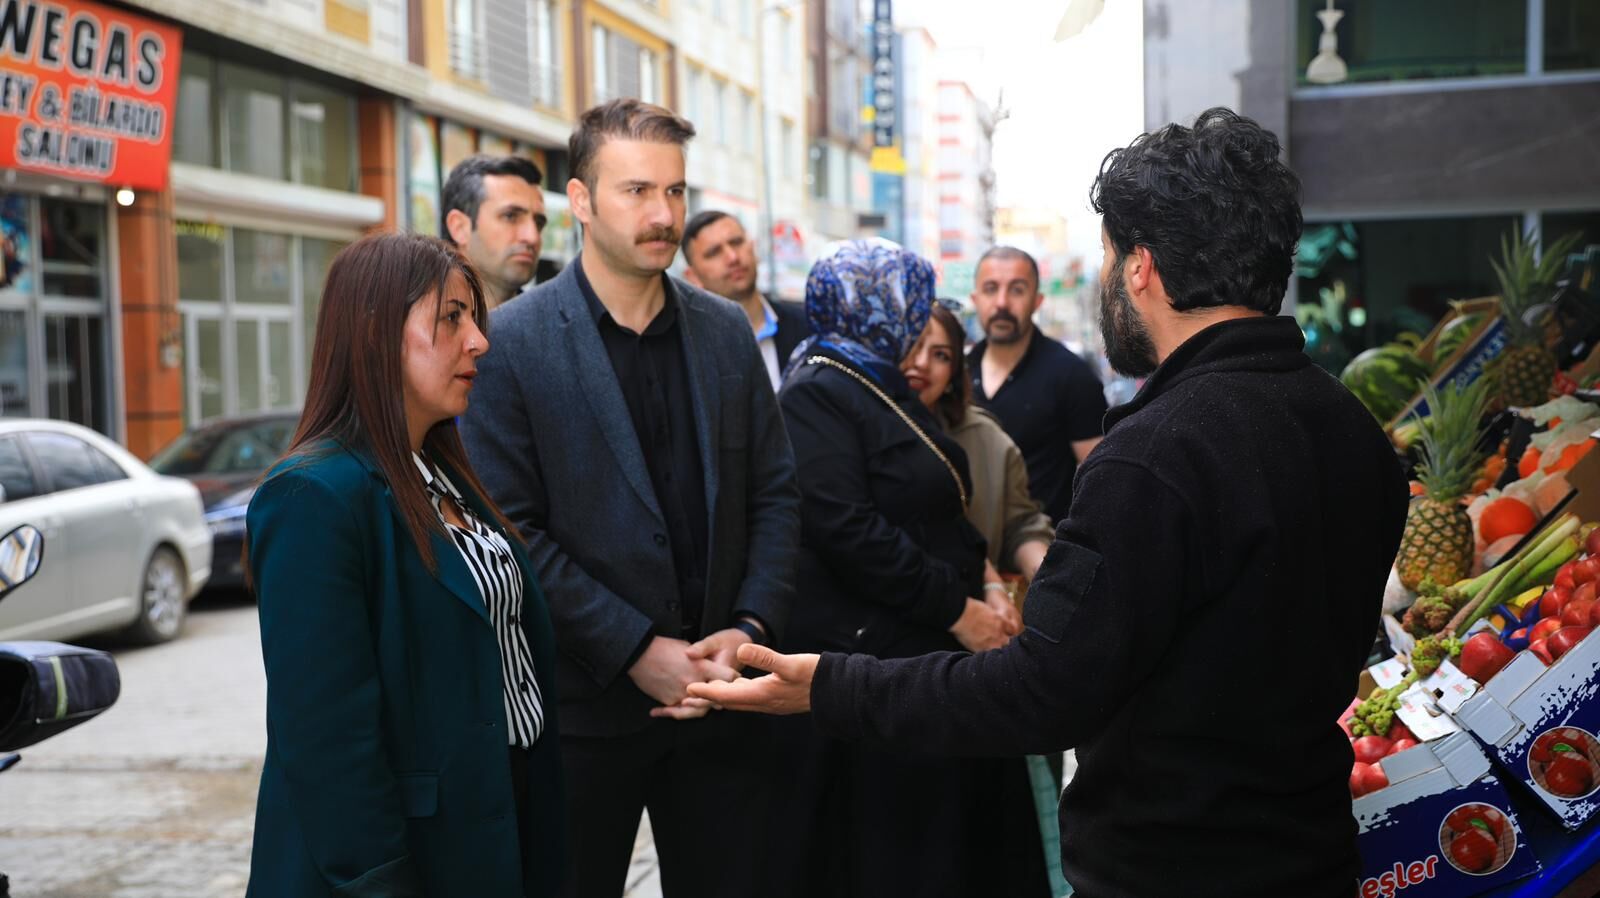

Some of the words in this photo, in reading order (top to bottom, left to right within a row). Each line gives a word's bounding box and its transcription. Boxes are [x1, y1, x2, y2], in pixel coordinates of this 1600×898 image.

[40, 87, 62, 121] &
[19, 125, 114, 171] SALONU
[1355, 855, 1439, 898] eşler
